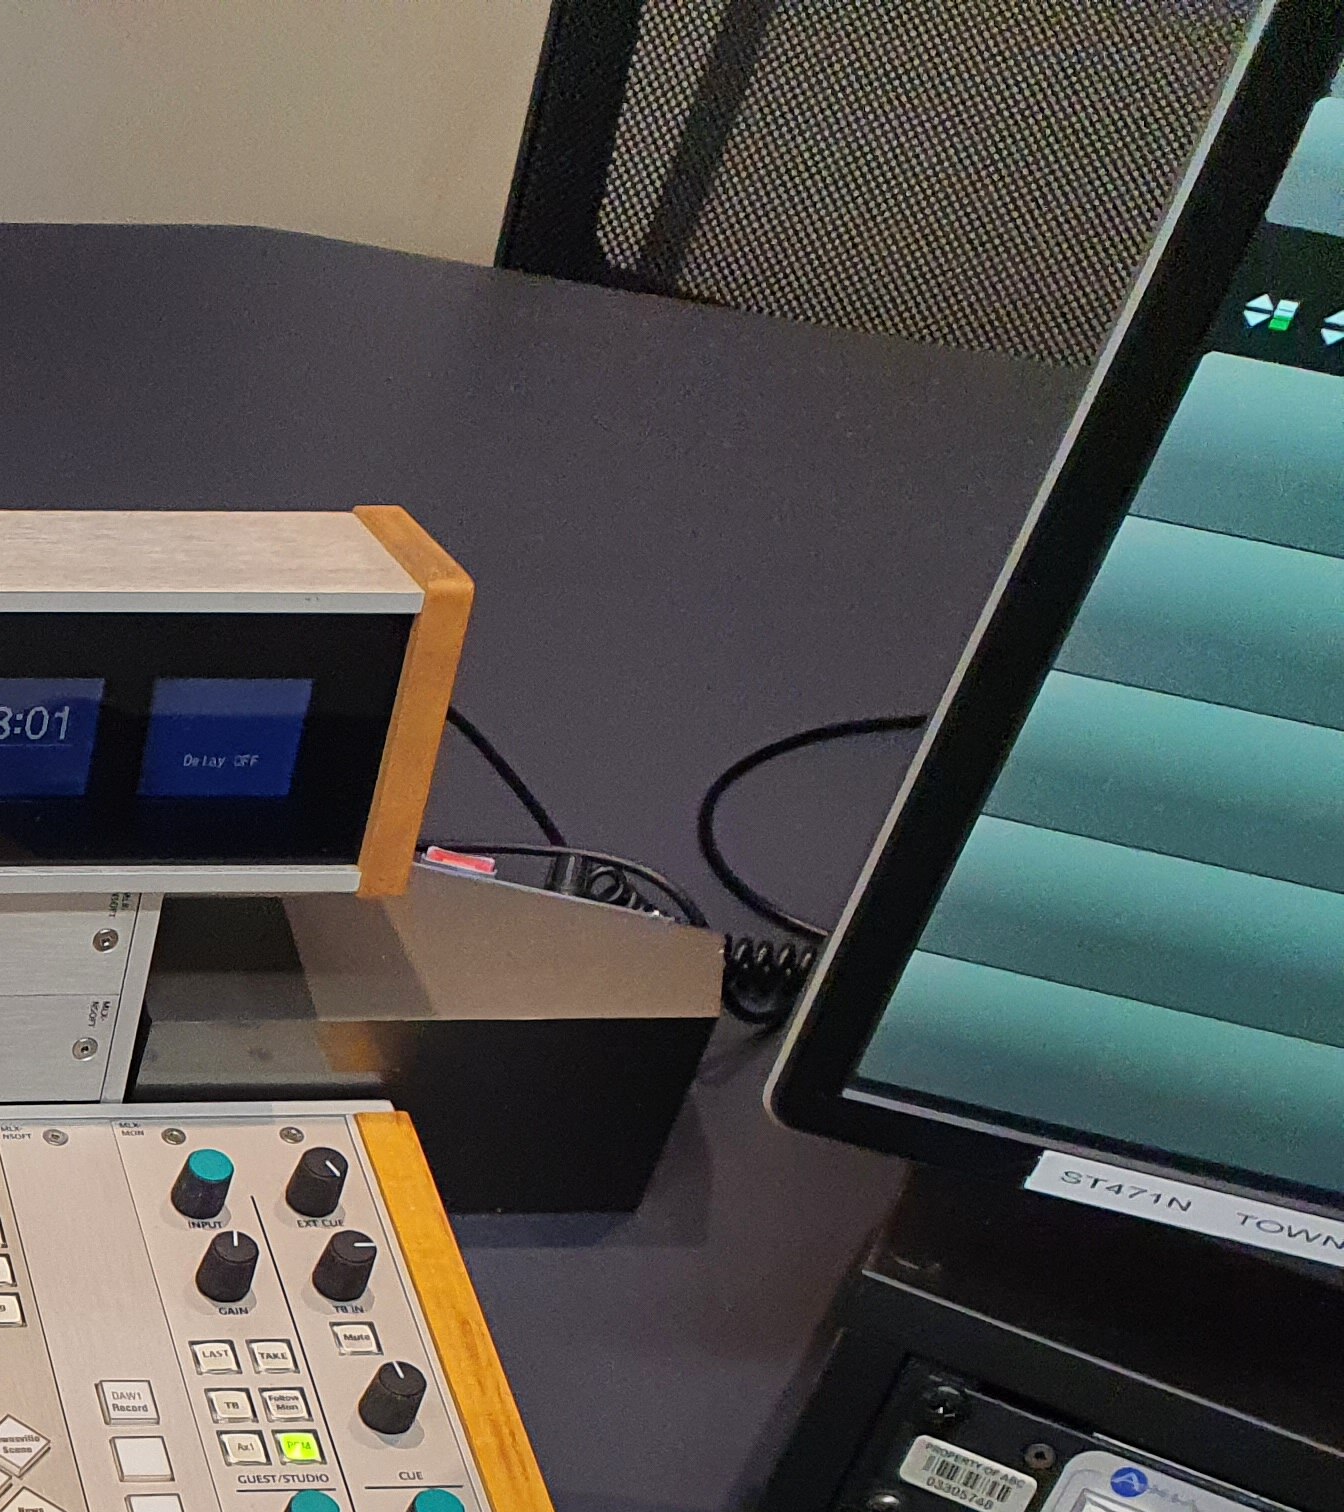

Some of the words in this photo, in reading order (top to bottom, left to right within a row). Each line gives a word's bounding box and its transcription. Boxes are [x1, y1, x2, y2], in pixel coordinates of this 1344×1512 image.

[183, 753, 225, 770] Delay
[1060, 1169, 1193, 1213] ST471N
[187, 1220, 223, 1230] INPUT
[296, 1218, 319, 1229] EXT
[320, 1218, 344, 1228] CUE
[218, 1305, 249, 1316] GAIN
[258, 1351, 288, 1361] TAKE
[111, 1389, 142, 1402] DAW1
[111, 1402, 149, 1414] Record
[237, 1472, 330, 1486] GUEST/STUDIO
[399, 1470, 424, 1482] CUE
